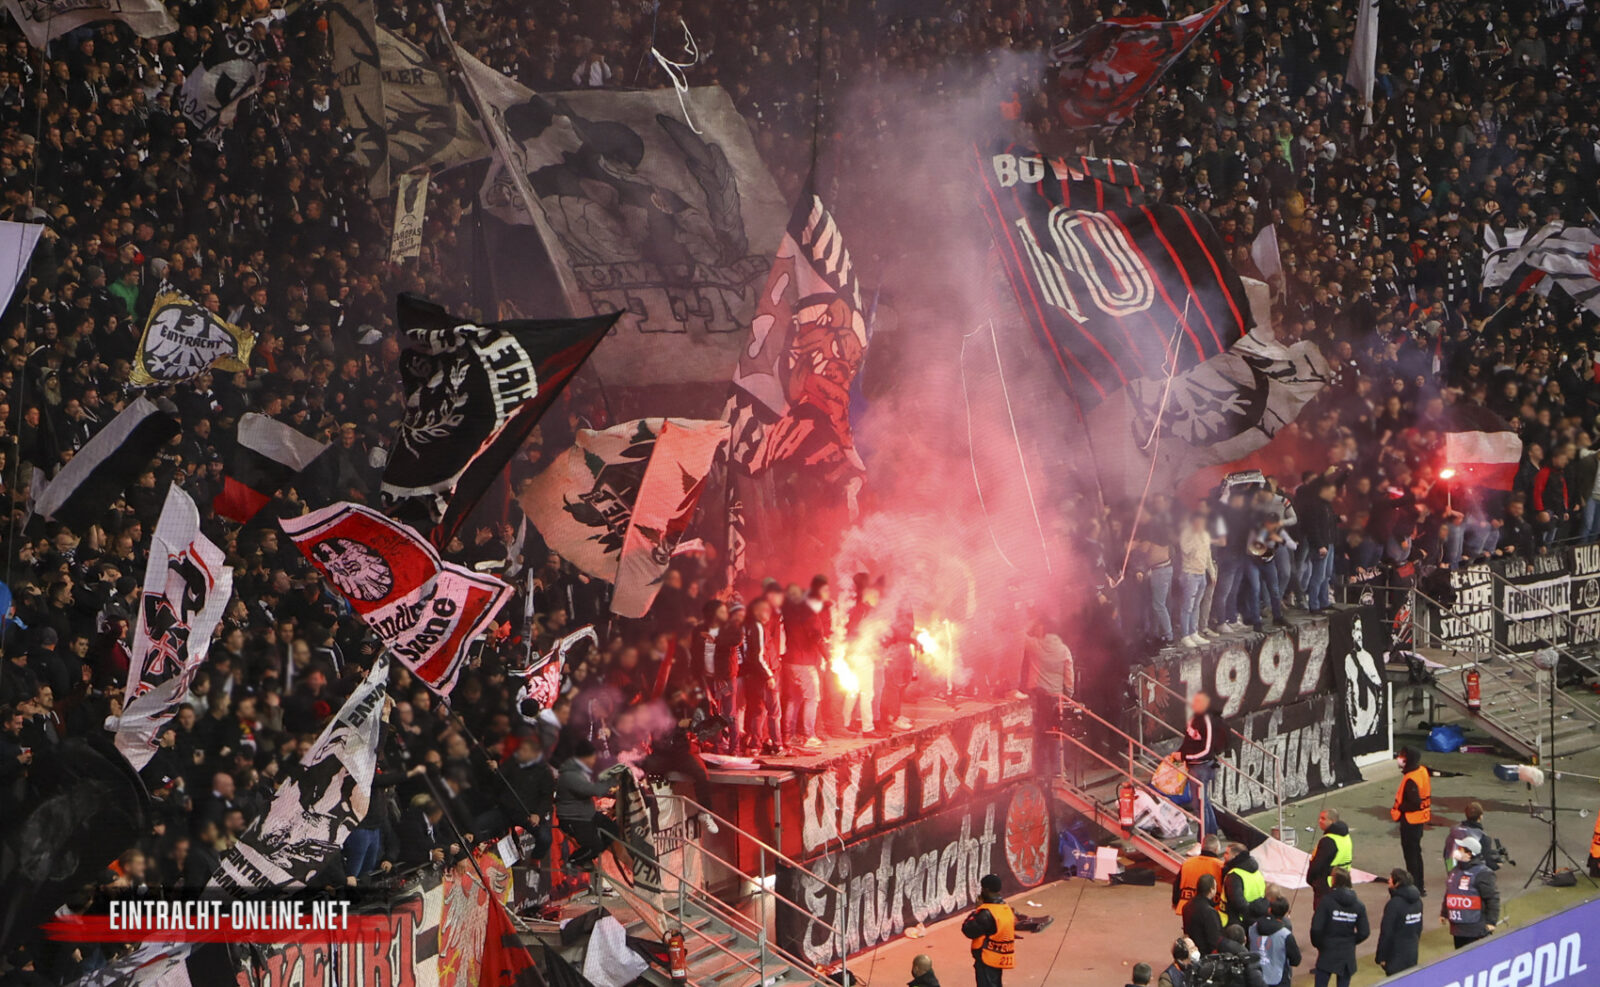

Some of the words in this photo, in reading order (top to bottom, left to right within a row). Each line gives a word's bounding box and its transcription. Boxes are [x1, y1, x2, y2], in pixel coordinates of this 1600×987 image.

[160, 324, 224, 349] EINTRACHT
[1440, 609, 1492, 638] STADION
[1508, 581, 1570, 614] FRANKFURT
[1180, 621, 1330, 728] 1997
[802, 703, 1034, 852] ULTRAS
[802, 803, 997, 968] Eintracht
